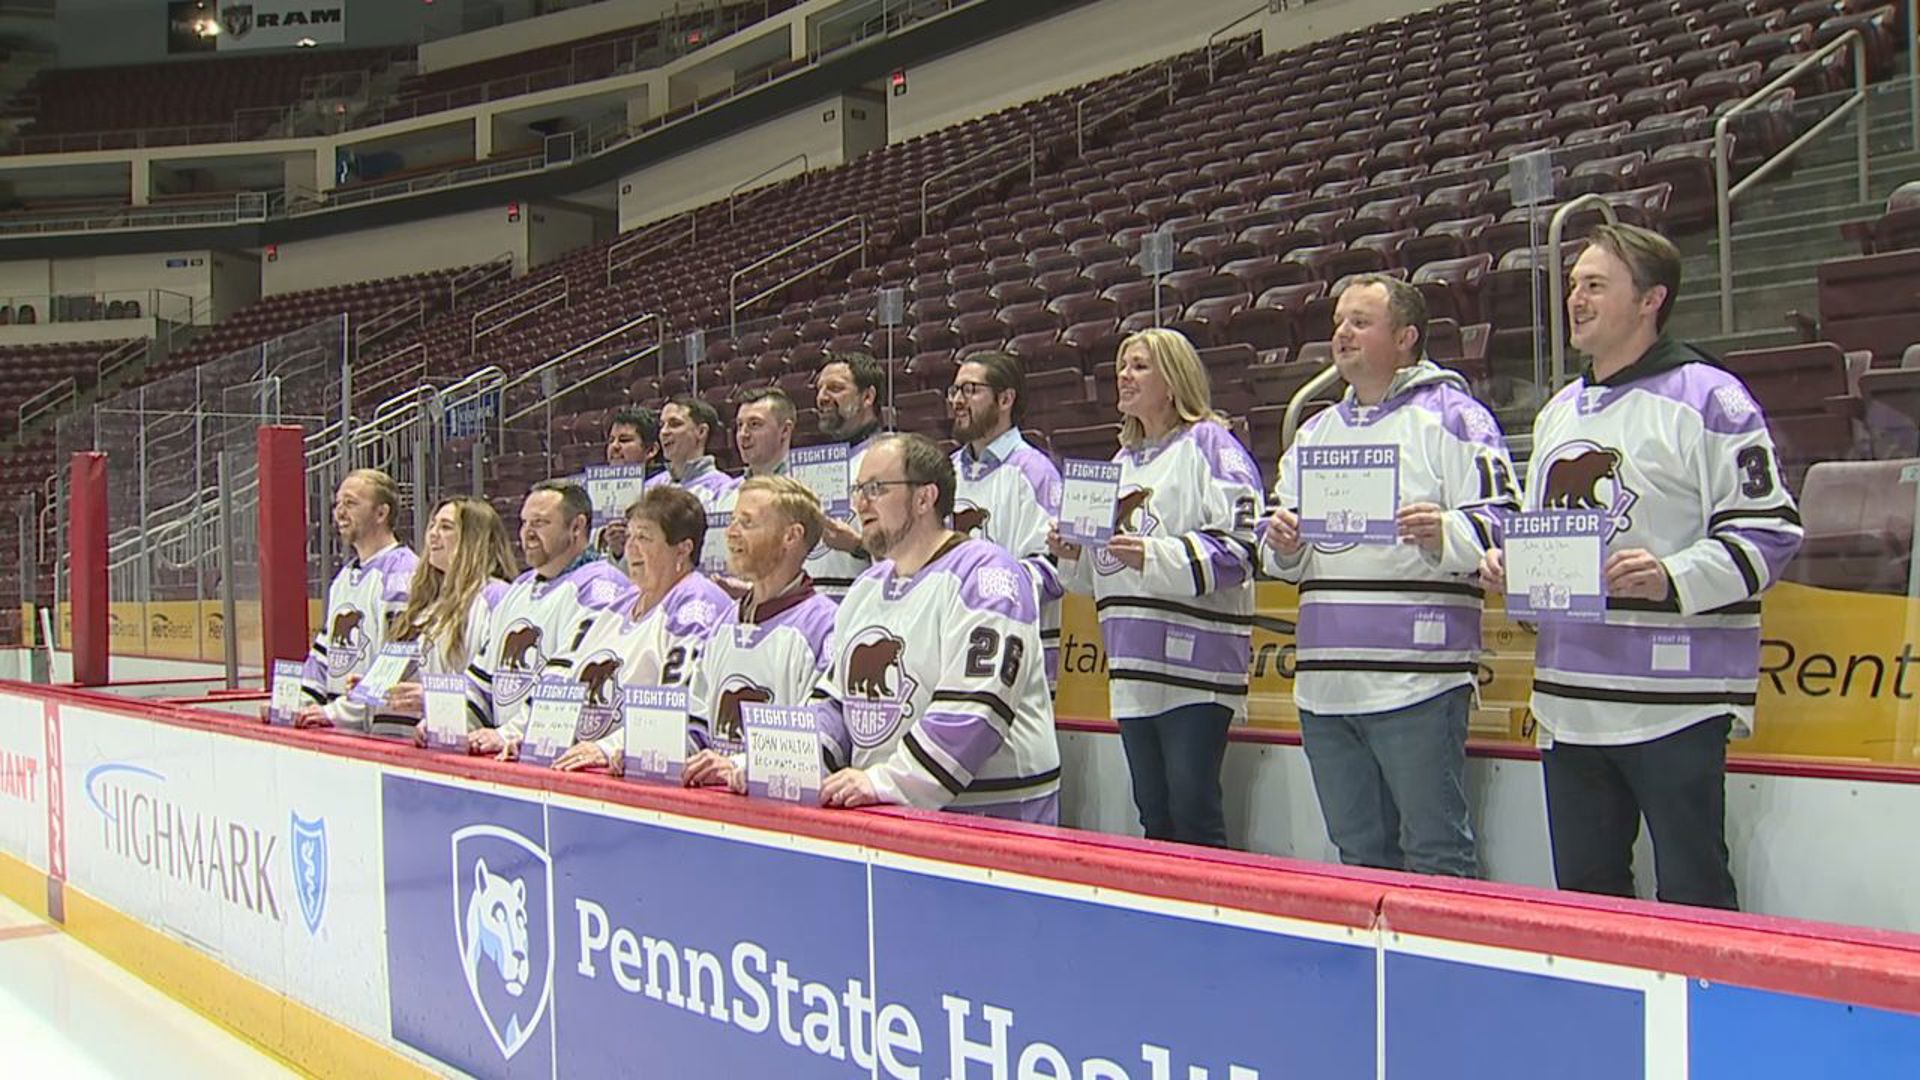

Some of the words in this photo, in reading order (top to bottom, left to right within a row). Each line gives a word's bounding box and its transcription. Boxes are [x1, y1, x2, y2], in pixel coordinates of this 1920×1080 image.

[257, 9, 341, 28] RAM
[791, 454, 797, 464] I
[798, 450, 826, 462] FIGHT
[828, 447, 847, 459] FOR
[1301, 451, 1309, 466] I
[1313, 449, 1360, 466] FIGHT
[1364, 449, 1395, 465] FOR
[587, 468, 592, 479] I
[593, 467, 620, 478] FIGHT
[623, 466, 641, 477] FOR
[1065, 463, 1071, 476] I
[1072, 463, 1099, 478] FIGHT
[1101, 465, 1119, 480] FOR
[1504, 518, 1510, 534] I
[1514, 516, 1561, 534] FIGHT
[1565, 514, 1600, 532] FOR
[965, 626, 1025, 688] 26
[535, 685, 541, 698] I
[542, 685, 568, 699] FIGHT
[569, 686, 585, 700] FOR
[625, 689, 631, 704] I
[632, 689, 663, 706] FIGHT
[665, 692, 687, 708] FOR
[744, 707, 751, 723] I
[752, 708, 788, 726] FIGHT
[790, 711, 816, 729] FOR
[751, 732, 778, 752] JOHN
[102, 782, 281, 921] HIGHMARK
[575, 898, 923, 1080] PennState
